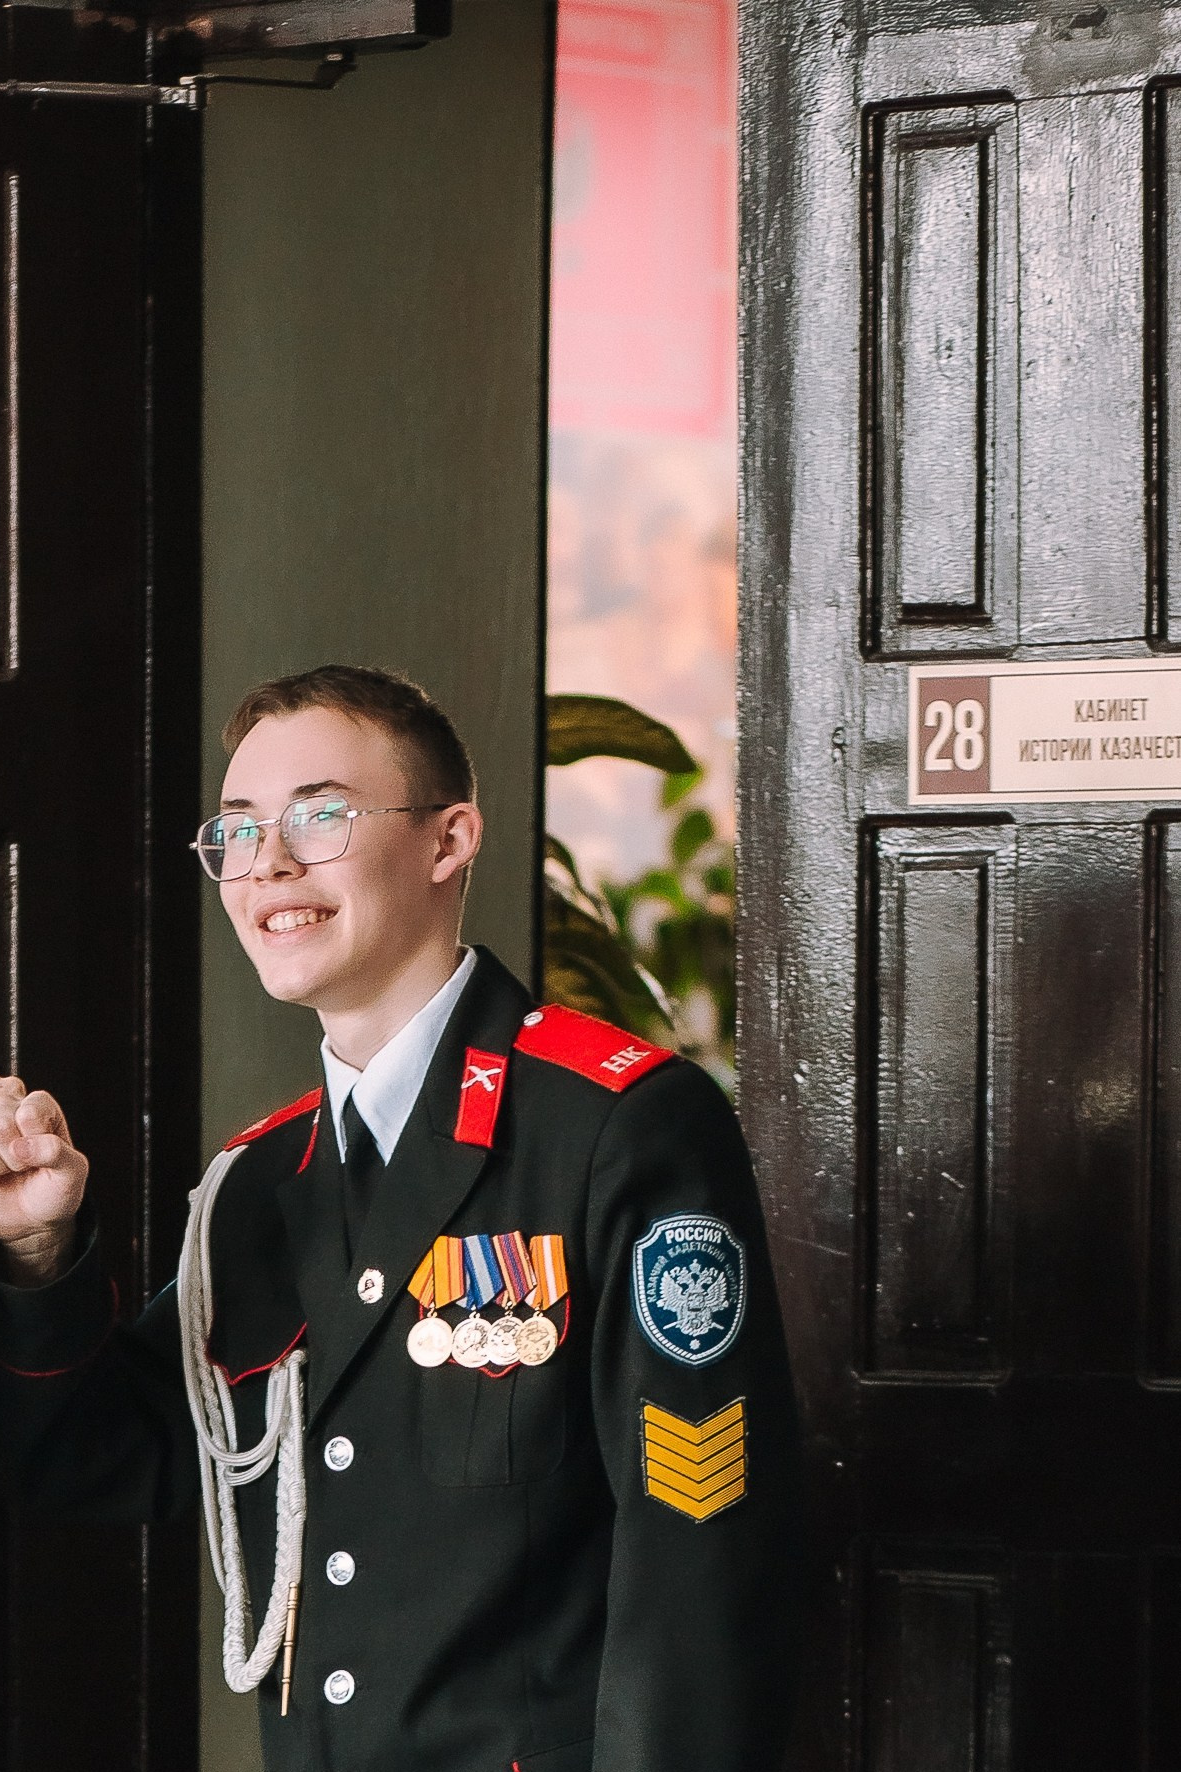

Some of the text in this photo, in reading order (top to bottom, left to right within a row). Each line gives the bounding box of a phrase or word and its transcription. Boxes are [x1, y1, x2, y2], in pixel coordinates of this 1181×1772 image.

[1074, 698, 1149, 722] КАБИНЕТ
[924, 699, 985, 771] 28
[1019, 738, 1092, 762] ИСТОРИИ
[665, 1226, 722, 1244] РОССИЯ
